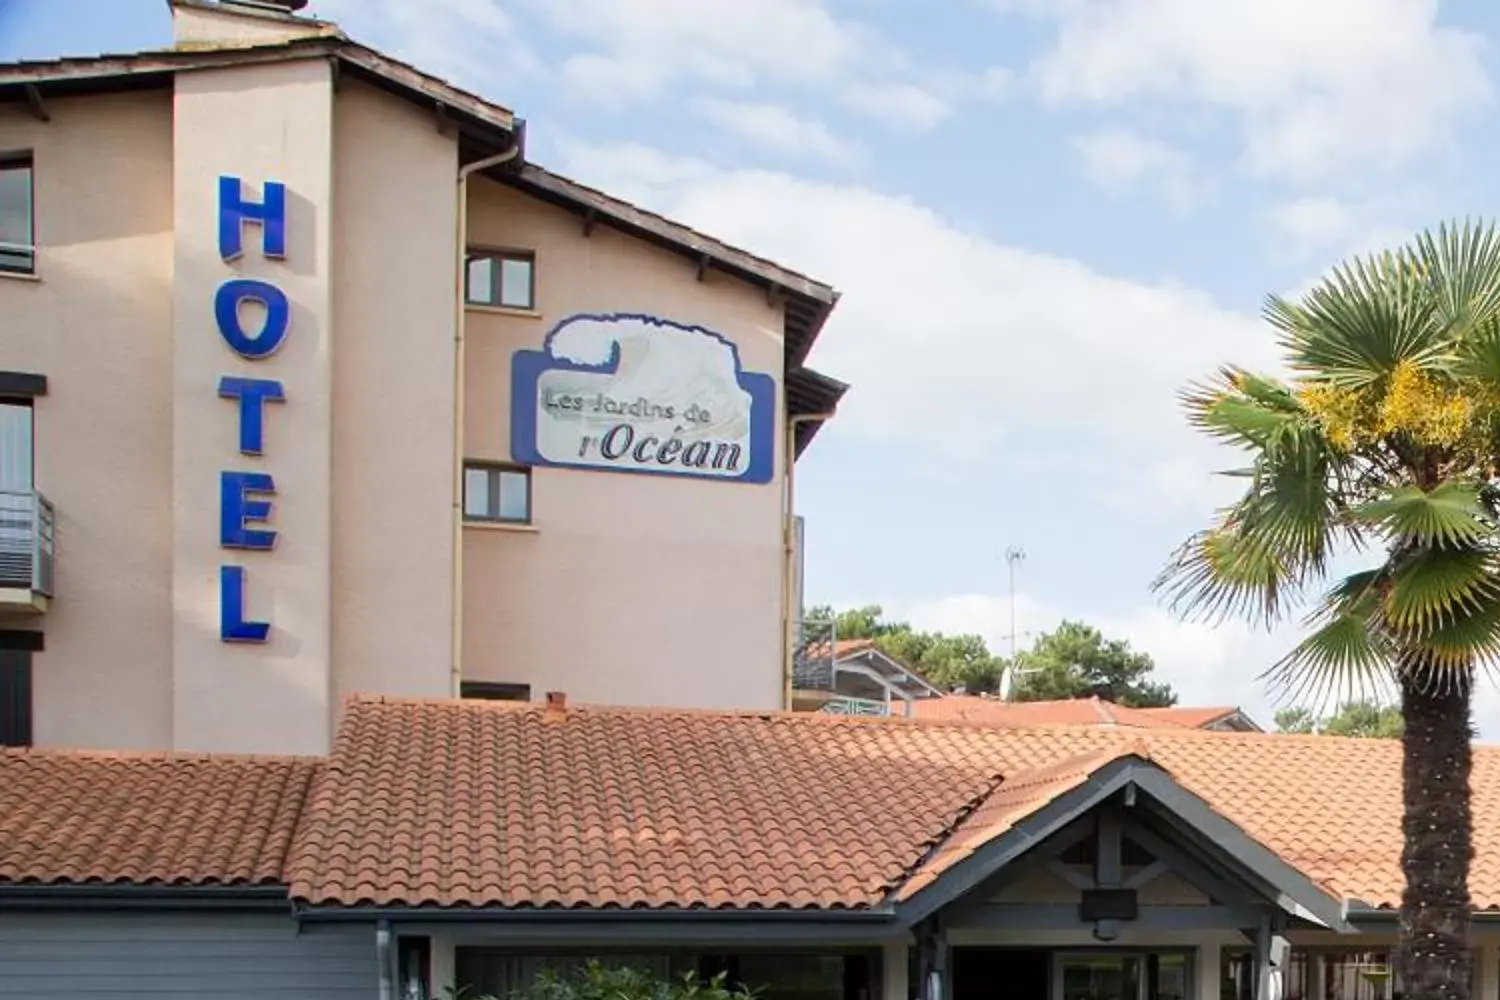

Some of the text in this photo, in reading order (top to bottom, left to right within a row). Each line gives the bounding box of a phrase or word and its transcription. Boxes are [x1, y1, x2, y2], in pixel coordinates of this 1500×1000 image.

[214, 175, 290, 642] HOTEL
[545, 389, 584, 413] Les
[683, 402, 711, 423] de
